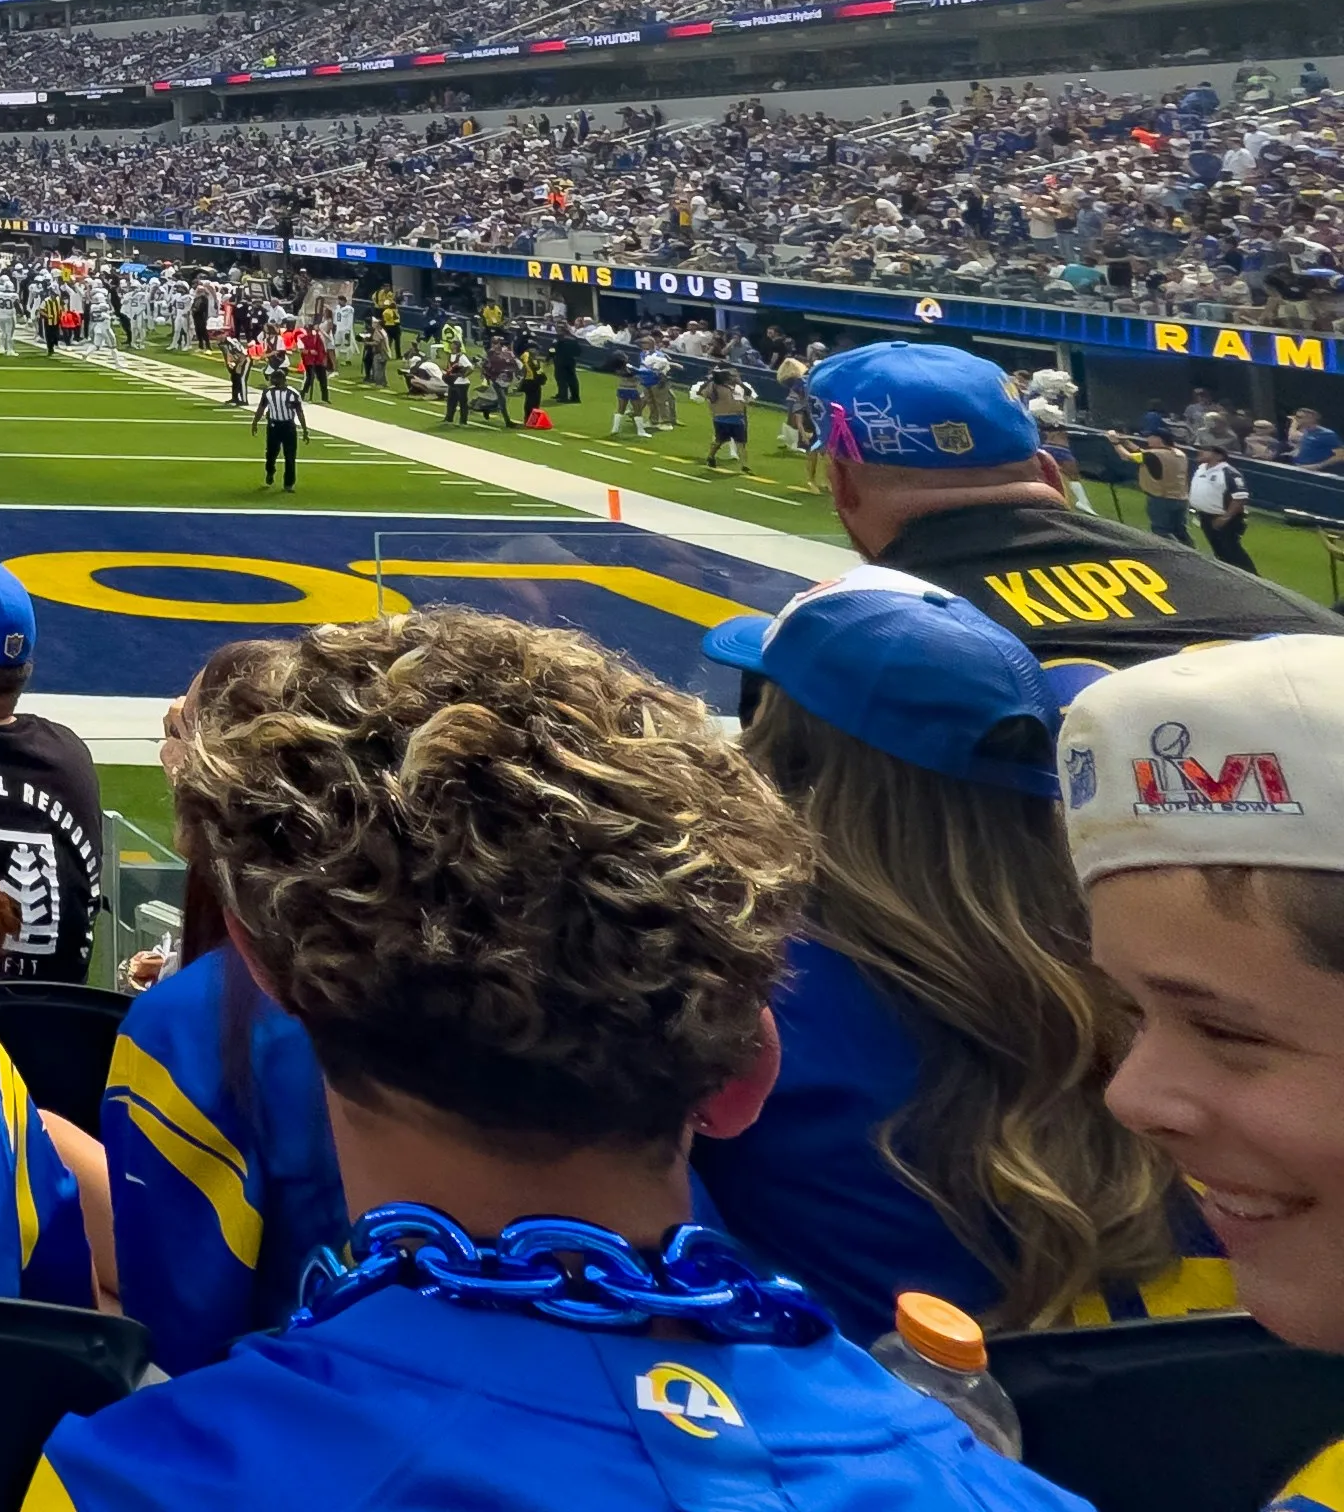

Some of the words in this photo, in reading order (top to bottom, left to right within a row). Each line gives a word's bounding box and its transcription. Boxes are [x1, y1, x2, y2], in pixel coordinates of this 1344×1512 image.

[793, 9, 822, 22] Hybrid
[594, 31, 640, 46] HYUNDAI
[527, 261, 613, 287] RAMS
[635, 270, 760, 303] HOUSE
[985, 560, 1177, 627] KUPP
[1132, 753, 1293, 804] LVI
[1222, 801, 1282, 812] BOWL
